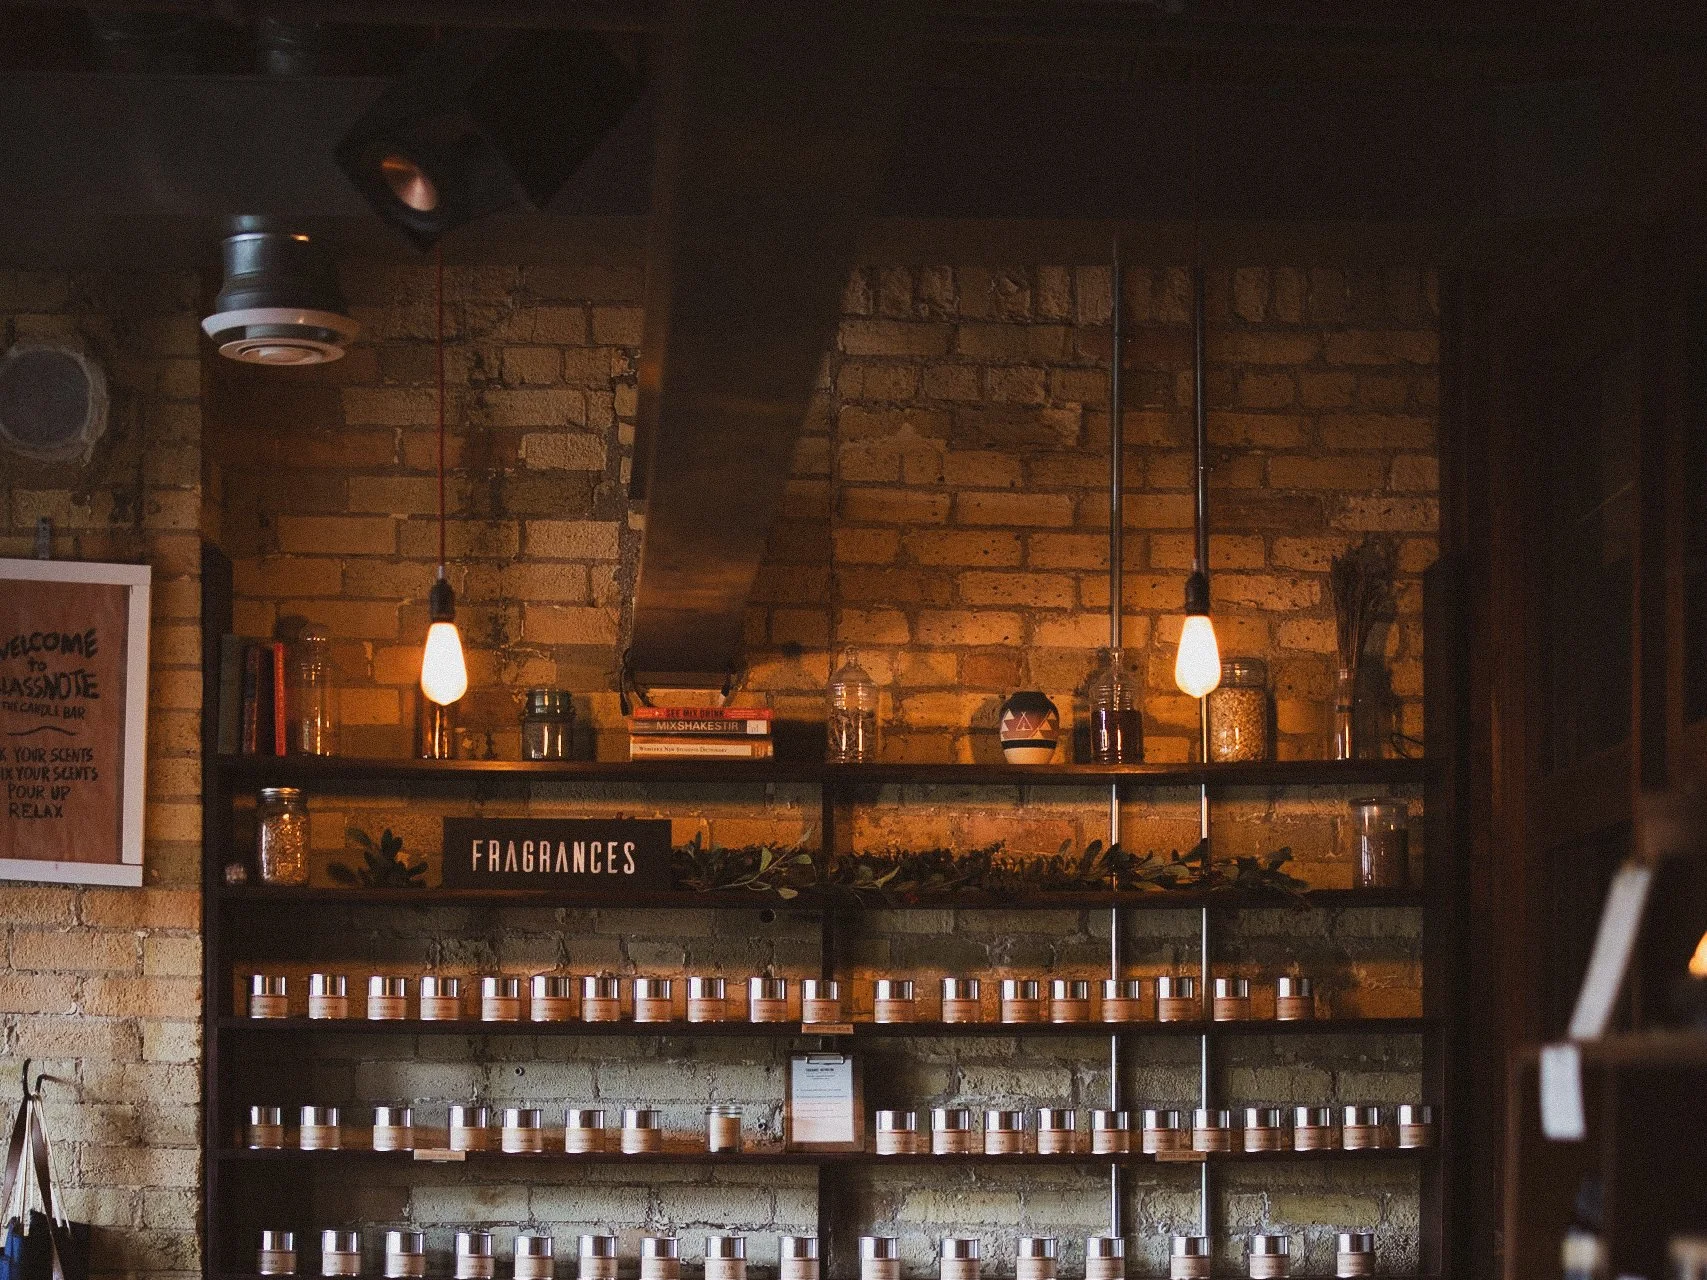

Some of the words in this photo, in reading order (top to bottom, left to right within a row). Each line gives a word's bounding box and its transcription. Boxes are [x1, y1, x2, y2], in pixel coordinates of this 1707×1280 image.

[0, 668, 99, 700] LASSNOTE
[16, 766, 50, 781] YOUR
[8, 802, 63, 819] RELAX
[472, 839, 636, 875] FRAGRANCES
